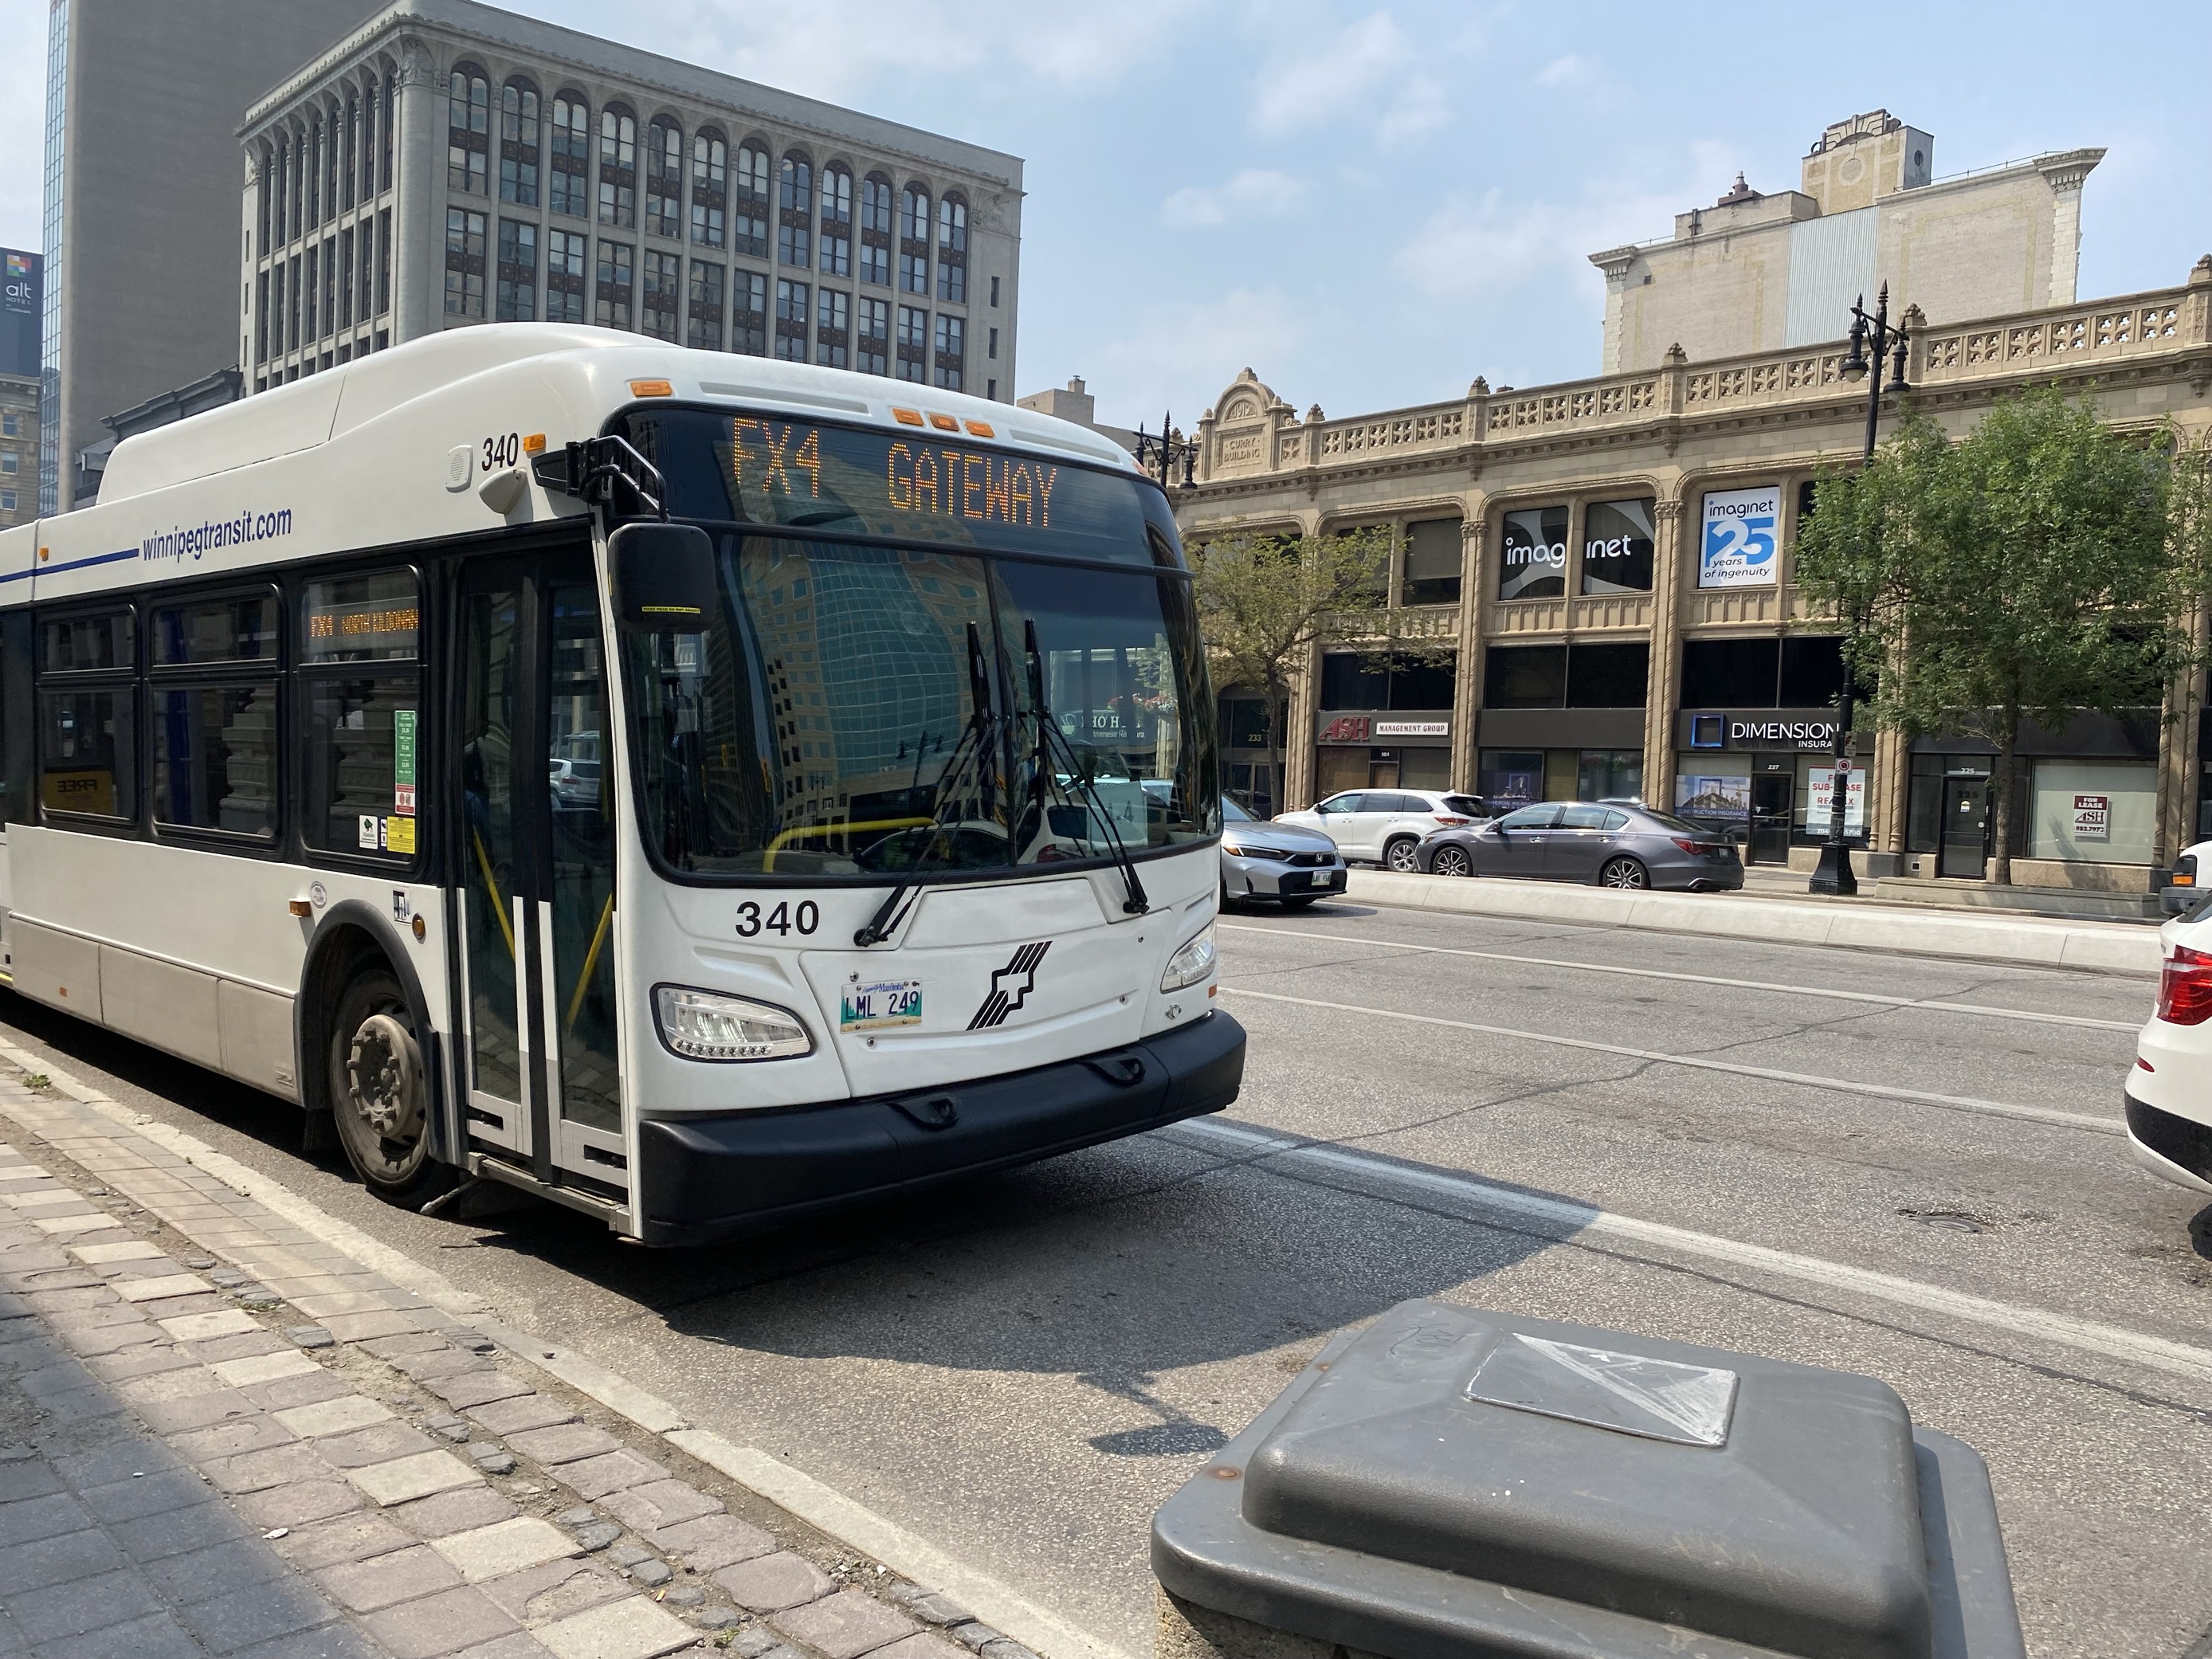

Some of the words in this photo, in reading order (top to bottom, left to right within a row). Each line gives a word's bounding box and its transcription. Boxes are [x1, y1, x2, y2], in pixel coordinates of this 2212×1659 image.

[6, 281, 32, 299] alt
[6, 296, 32, 305] HOTEL
[1230, 437, 1257, 449] CURRY
[481, 431, 520, 472] 340
[1224, 448, 1261, 462] BUILDING
[733, 416, 820, 500] FX4
[888, 442, 1057, 528] GATEWAY
[1708, 499, 1774, 519] imaginet
[143, 508, 292, 564] winnipegtransit.com
[1706, 516, 1775, 567] 25
[1712, 558, 1743, 569] years
[1704, 569, 1716, 578] of
[1717, 567, 1771, 578] ingenuity
[1318, 715, 1371, 741] ASH
[1379, 724, 1422, 733] MANAGEMENT
[1422, 724, 1445, 733] GROUP
[1731, 722, 1840, 739] DIMENSION
[1798, 739, 1833, 748] INSURA
[1812, 782, 1862, 791] SUB-ASE
[1817, 797, 1854, 806] RE/X
[1956, 790, 1979, 799] 225
[2074, 811, 2105, 822] ASH
[735, 900, 820, 938] 340
[879, 982, 904, 993] Manitoba
[845, 994, 877, 1020] LML
[888, 990, 920, 1015] 249
